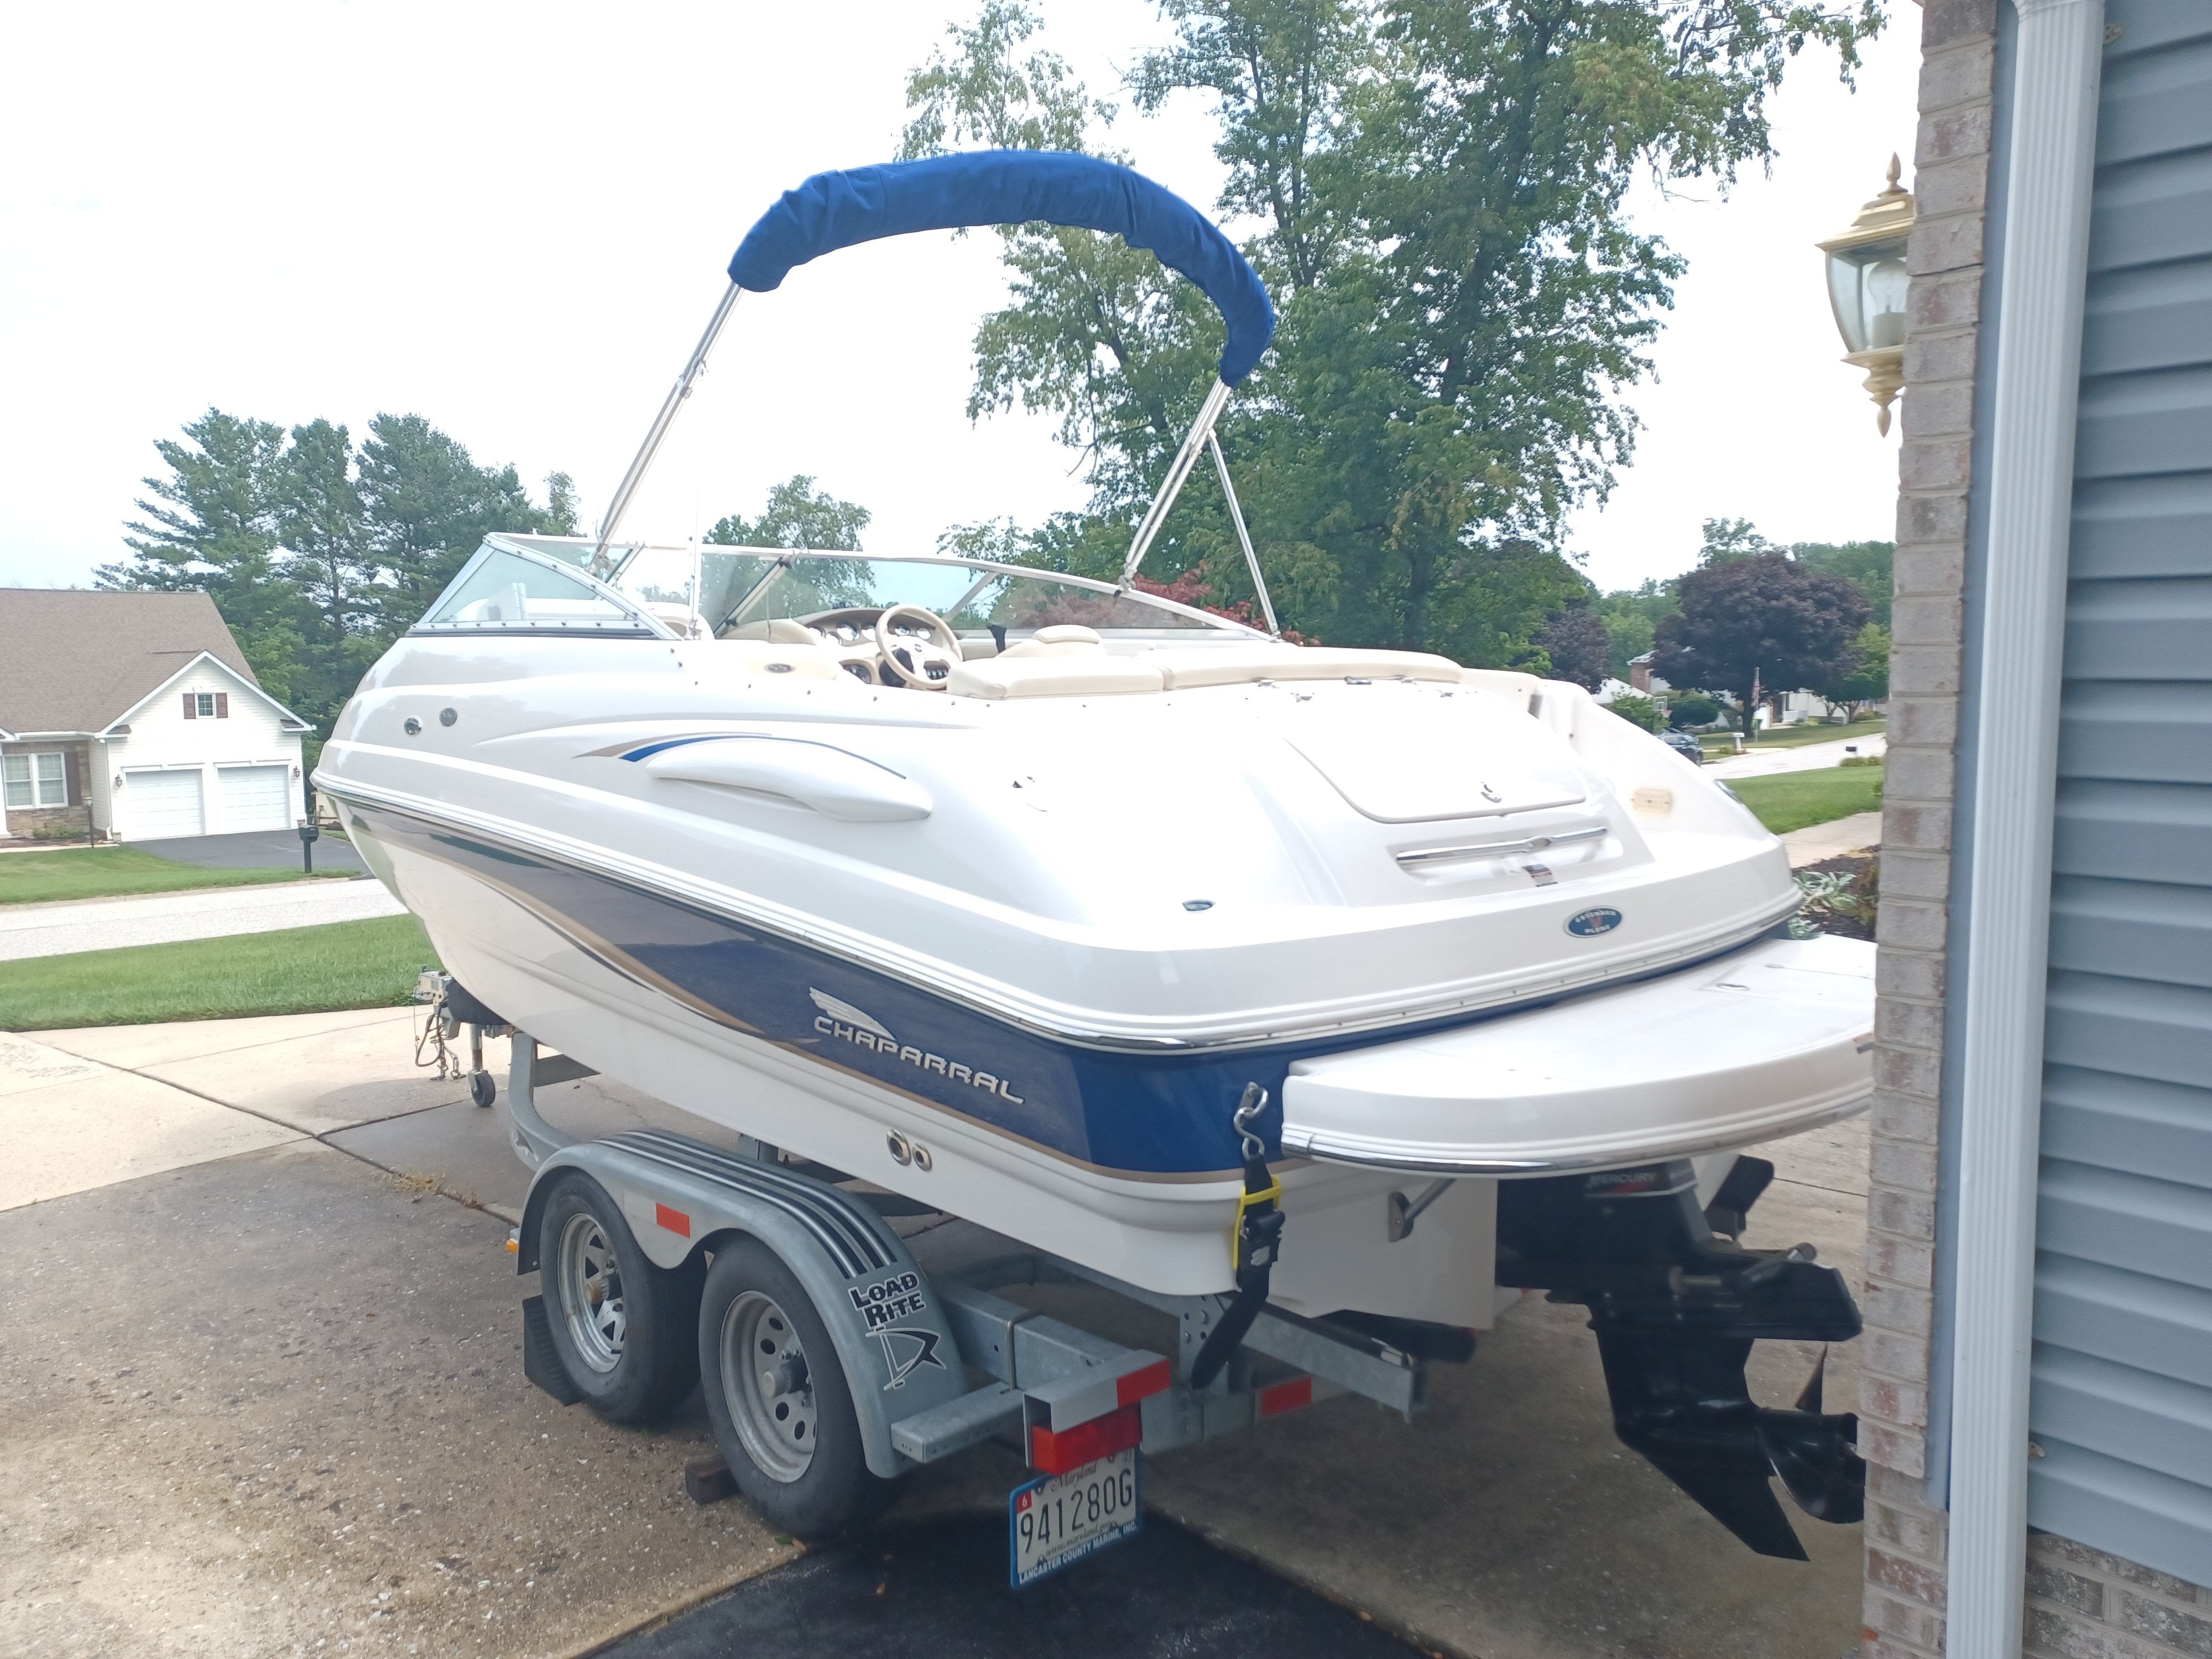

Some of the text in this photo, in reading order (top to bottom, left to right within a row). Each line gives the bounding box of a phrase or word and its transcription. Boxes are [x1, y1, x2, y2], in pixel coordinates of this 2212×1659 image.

[814, 1016, 1024, 1104] CHAPARRAL
[849, 1271, 919, 1311] LOAD
[863, 1290, 926, 1329] RITE
[1051, 1460, 1097, 1492] Maryland
[1020, 1468, 1132, 1554] 941280G
[1022, 1495, 1027, 1507] 6
[1019, 1556, 1061, 1585] LANCASTER
[1062, 1542, 1091, 1564] COUNTY
